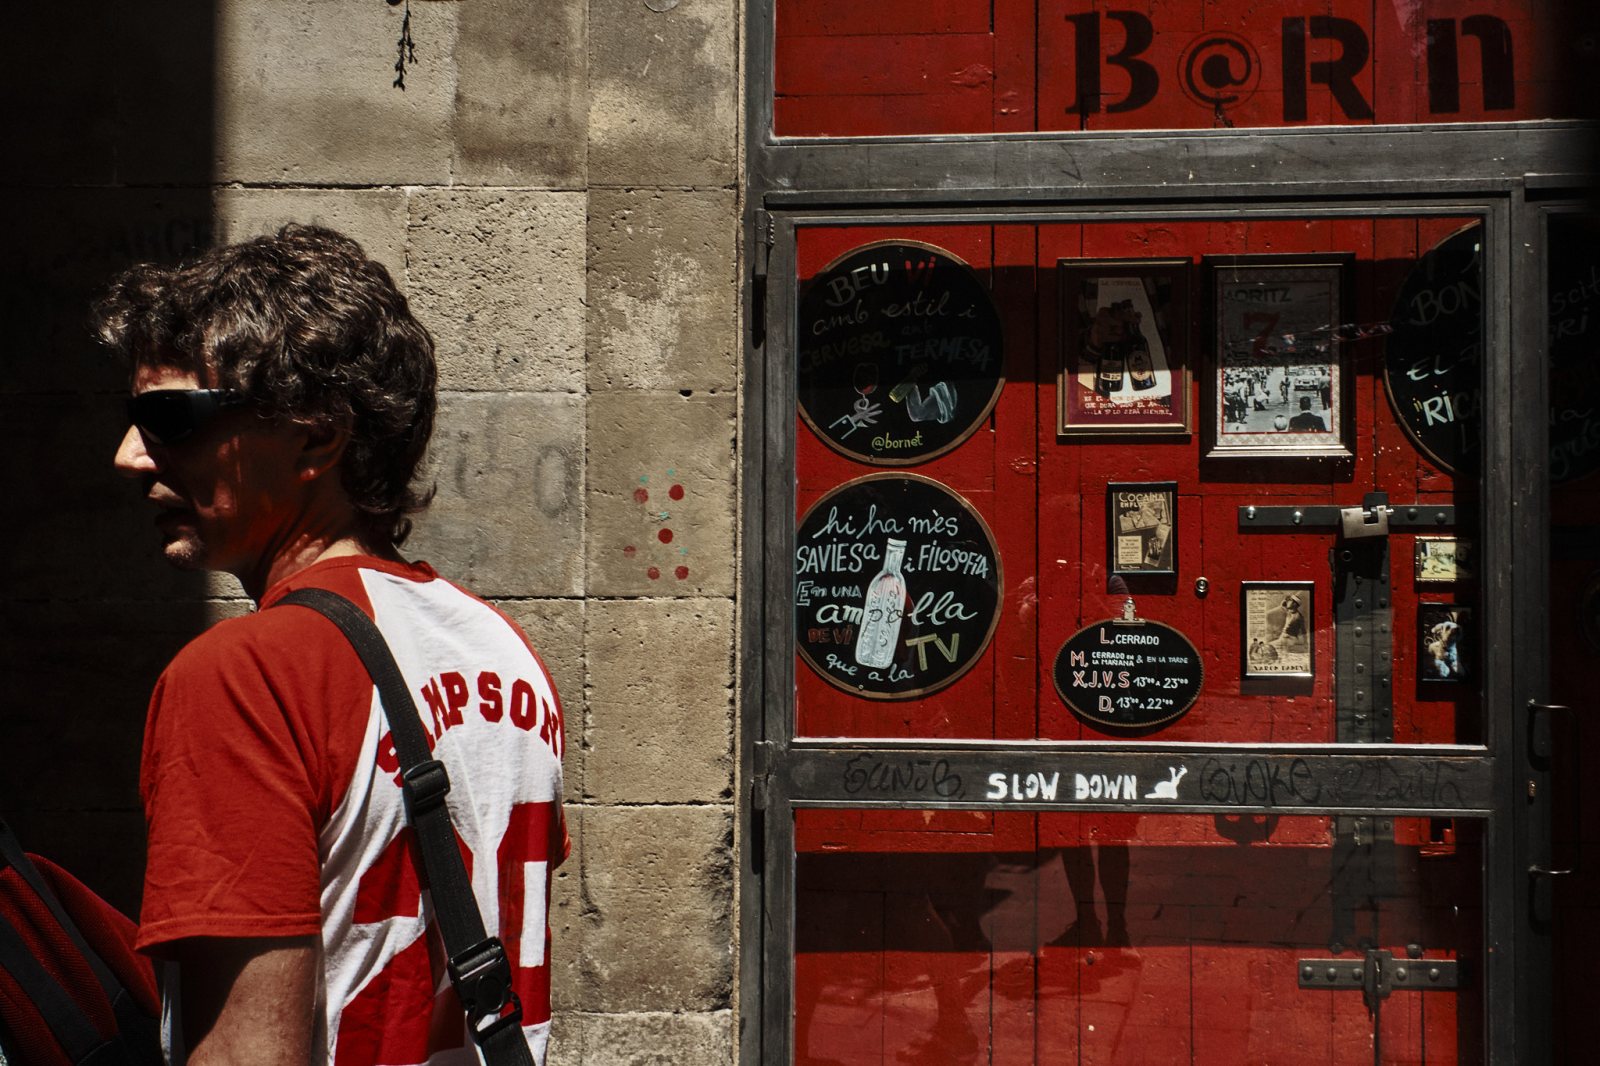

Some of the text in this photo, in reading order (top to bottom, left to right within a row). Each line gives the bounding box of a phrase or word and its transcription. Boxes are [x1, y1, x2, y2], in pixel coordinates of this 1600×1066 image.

[825, 262, 890, 307] BEU
[812, 299, 869, 335] amb
[881, 290, 950, 318] estil
[871, 430, 924, 451] @bornet
[812, 505, 856, 539] hi
[856, 503, 904, 540] ha
[832, 584, 862, 599] UNA
[807, 627, 828, 644] DE
[1115, 634, 1160, 646] CERRADO
[825, 632, 960, 683] que a la TV
[1091, 651, 1125, 660] CERRADO
[1168, 656, 1189, 664] TARDE
[376, 671, 558, 788] MPSON
[986, 771, 1137, 800] SLOW DOWN
